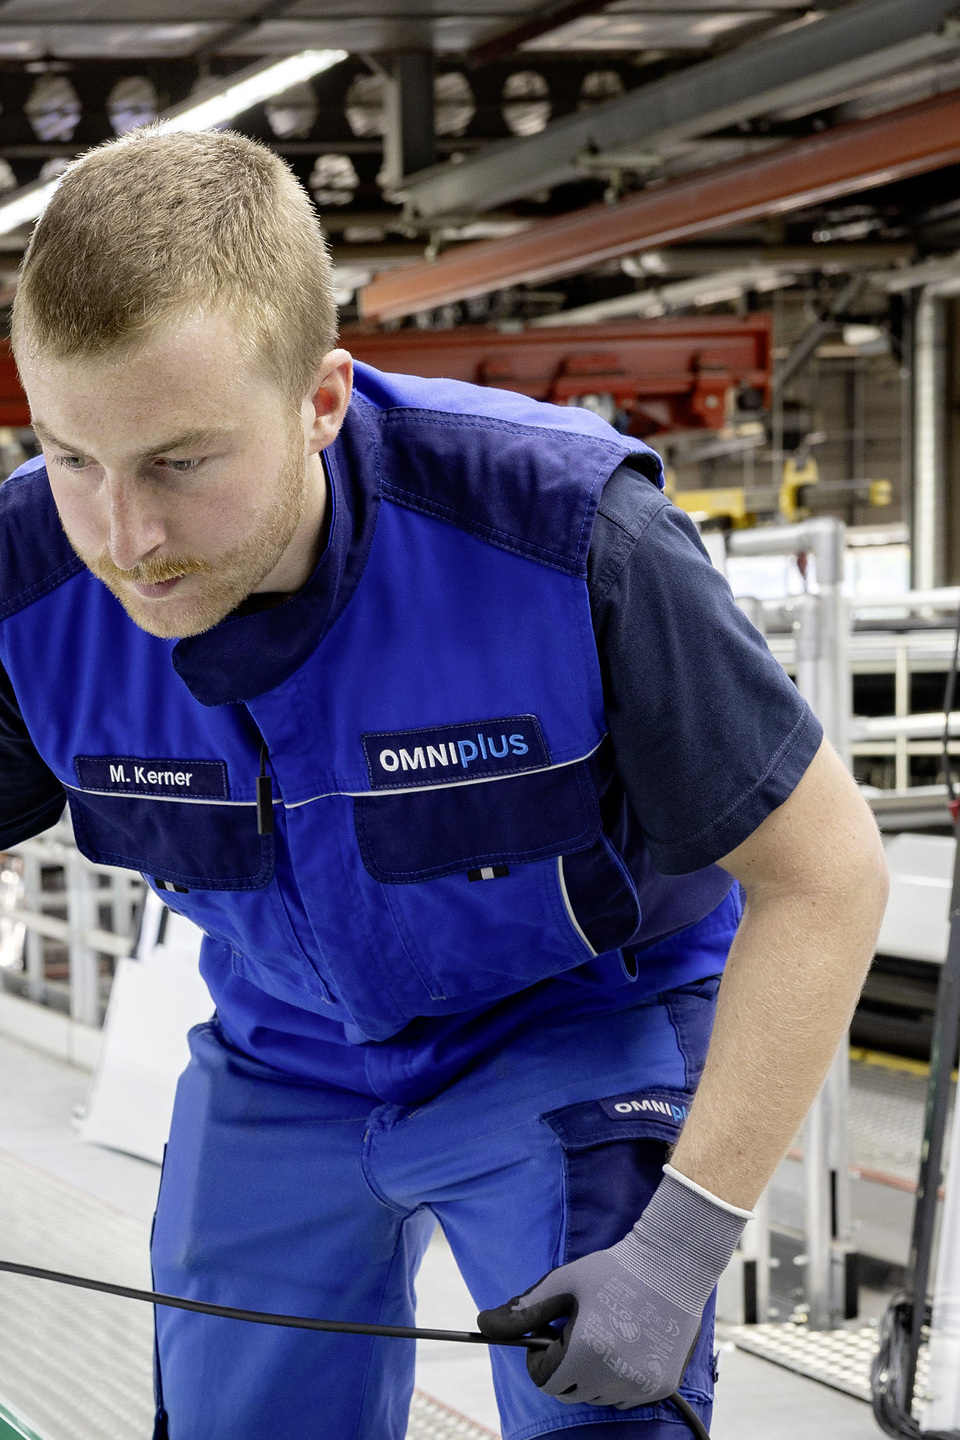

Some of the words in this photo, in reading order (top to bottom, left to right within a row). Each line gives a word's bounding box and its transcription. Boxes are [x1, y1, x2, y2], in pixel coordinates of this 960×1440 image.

[109, 764, 131, 783] M.
[134, 766, 193, 787] Kerner
[614, 1100, 688, 1122] OMNIpl
